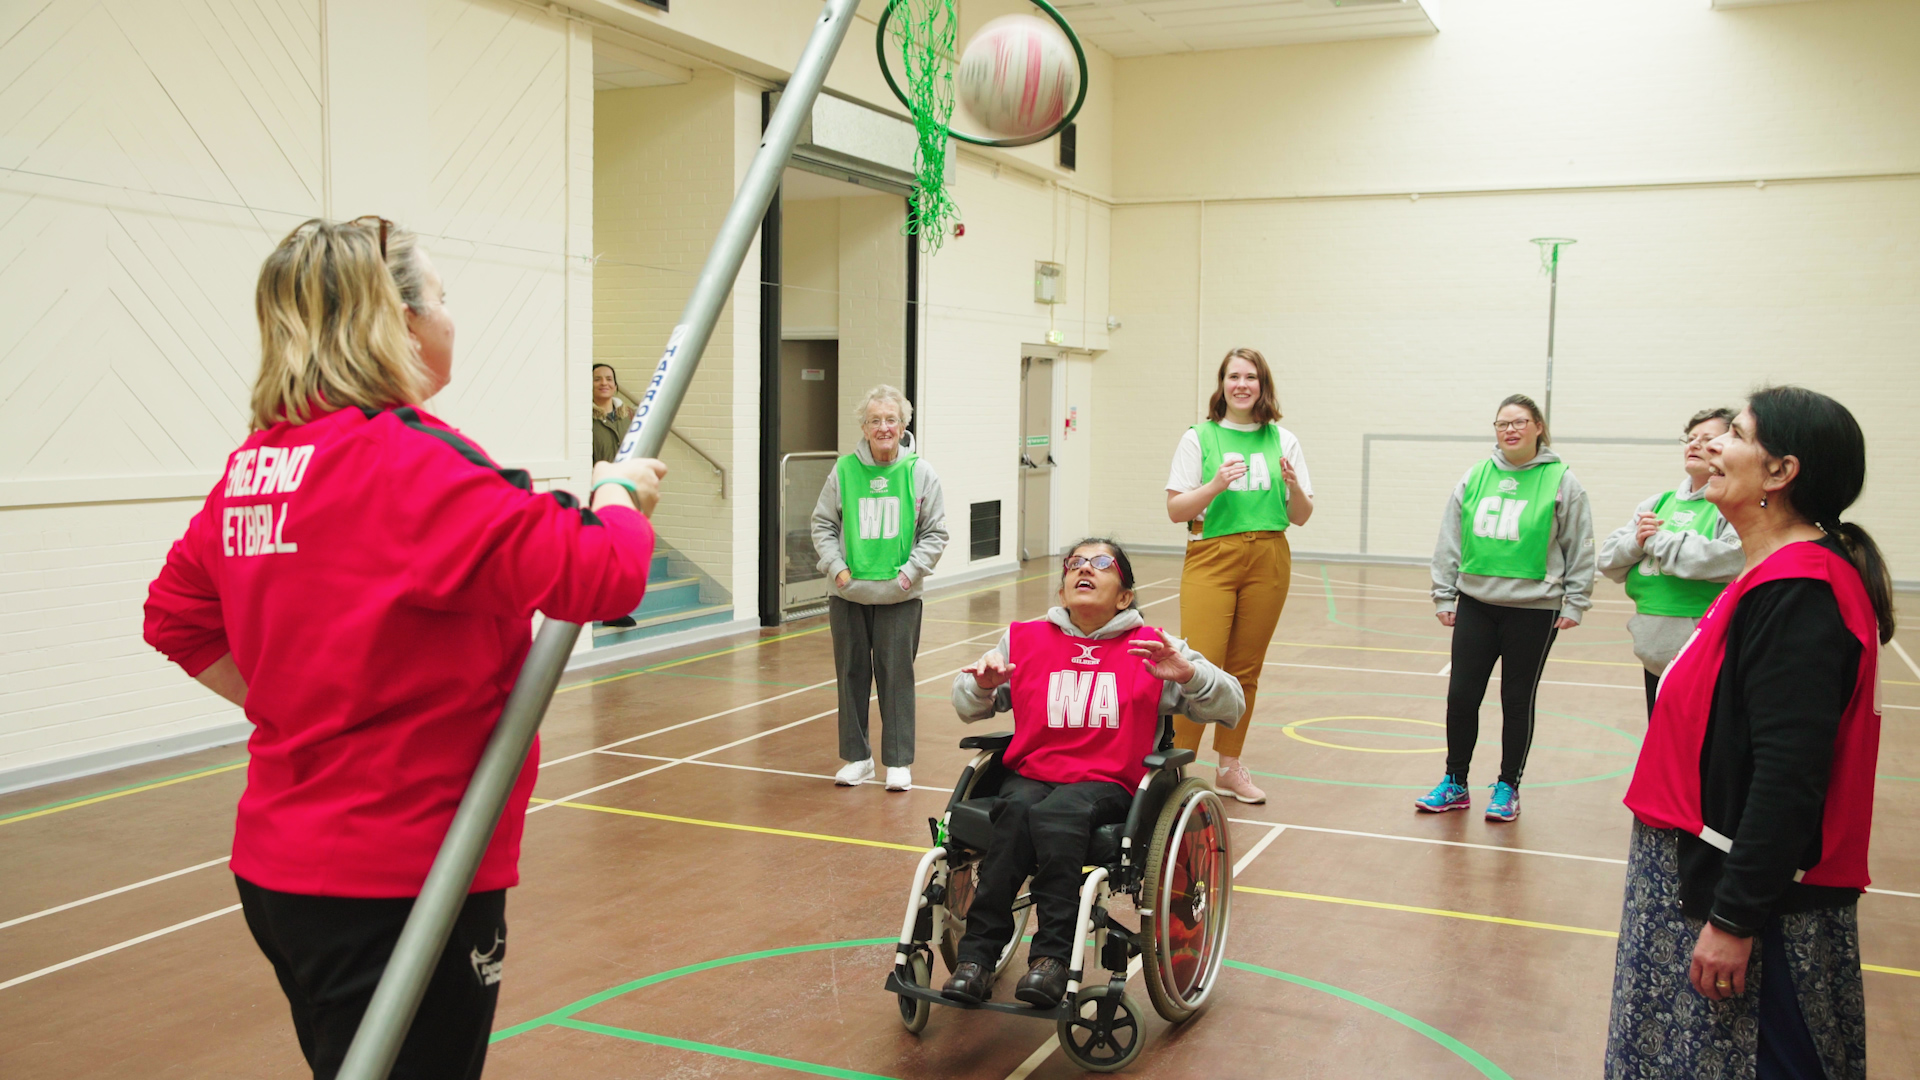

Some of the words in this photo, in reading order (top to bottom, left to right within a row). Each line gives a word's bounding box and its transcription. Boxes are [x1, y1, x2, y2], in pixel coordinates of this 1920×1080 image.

[628, 345, 677, 433] HARROD
[222, 502, 298, 557] ETBALL
[858, 496, 900, 539] WD
[1473, 496, 1528, 540] GK
[1047, 670, 1119, 728] WA
